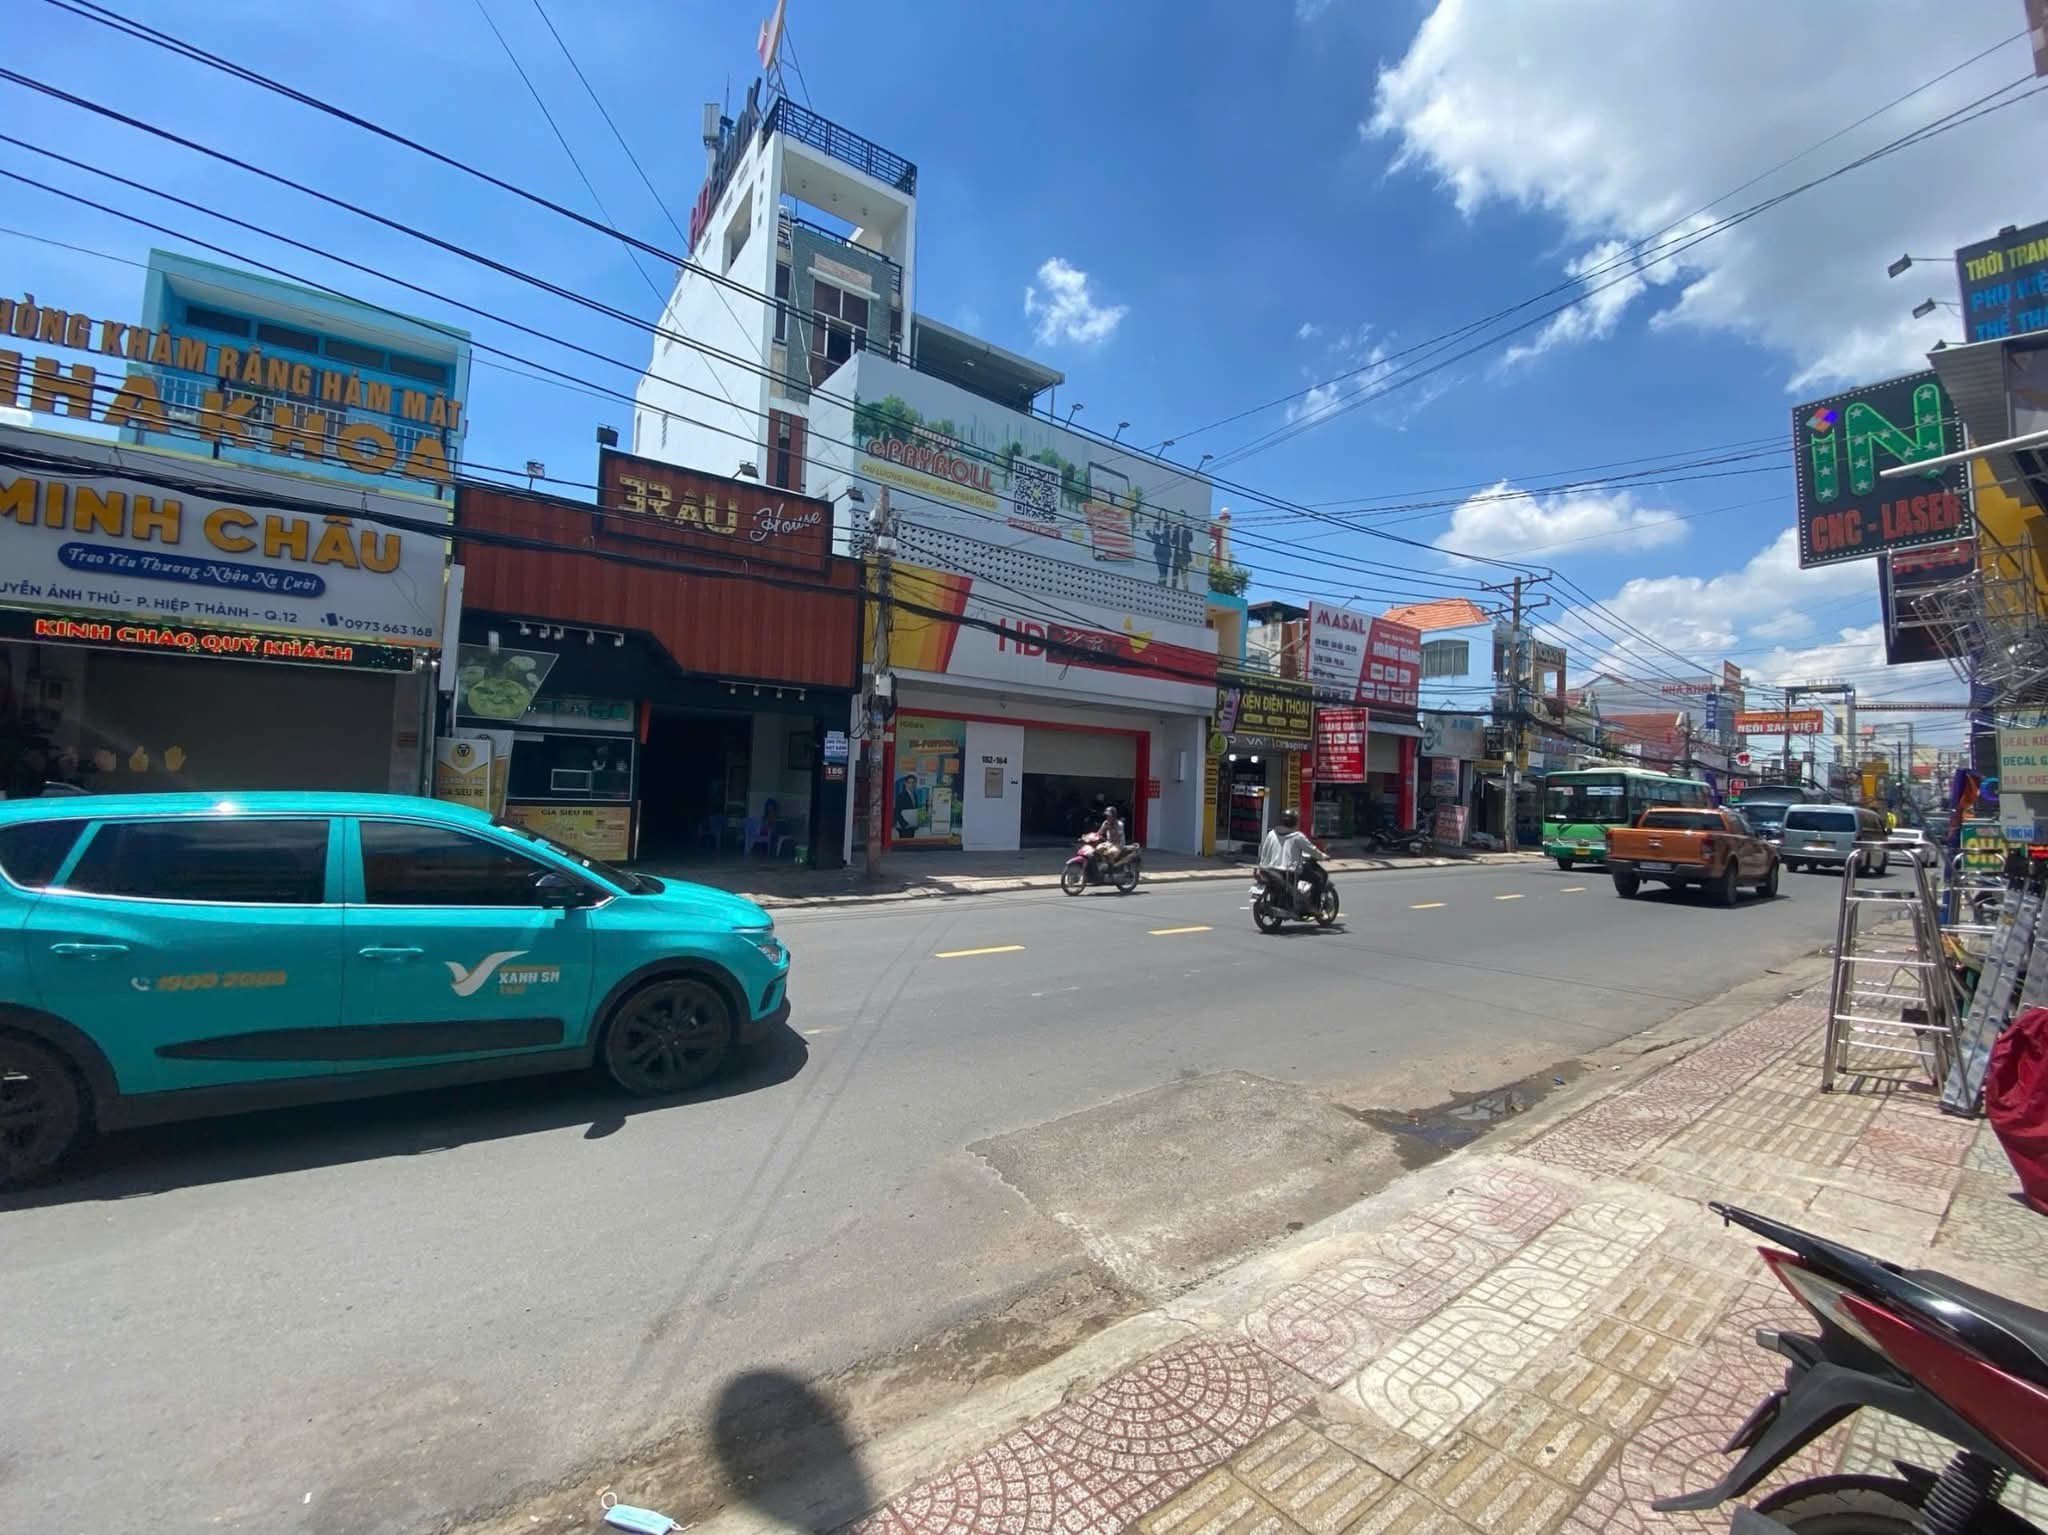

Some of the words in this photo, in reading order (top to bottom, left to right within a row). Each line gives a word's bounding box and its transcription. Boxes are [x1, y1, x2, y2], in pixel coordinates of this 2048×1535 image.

[1964, 250, 2004, 281] THỜI
[101, 319, 208, 373] KHÁM
[218, 345, 311, 395] RĂNG
[322, 367, 392, 413] HÀM
[402, 388, 463, 430] MẶT
[200, 389, 452, 482] KHOA
[203, 507, 402, 574] CHÂU
[750, 502, 823, 542] House
[1811, 508, 1863, 553] CNC
[1880, 491, 1962, 540] LASER
[68, 547, 105, 565] Trao
[109, 551, 137, 568] Yêu
[141, 556, 200, 580] Thương
[203, 565, 249, 583] Nhận
[252, 572, 278, 588] Nụ
[283, 575, 317, 592] Cười
[48, 584, 82, 600] ẢNH
[88, 590, 120, 605] THỦ
[137, 596, 150, 608] P.
[154, 597, 190, 612] HIỆP
[195, 602, 249, 617] THÀNH
[265, 609, 299, 623] Q.12
[1316, 609, 1366, 635] MASAL
[345, 618, 379, 632] 0973
[383, 621, 408, 634] 663
[413, 625, 433, 637] 168
[2002, 754, 2037, 767] DECAL
[498, 971, 538, 985] XANH
